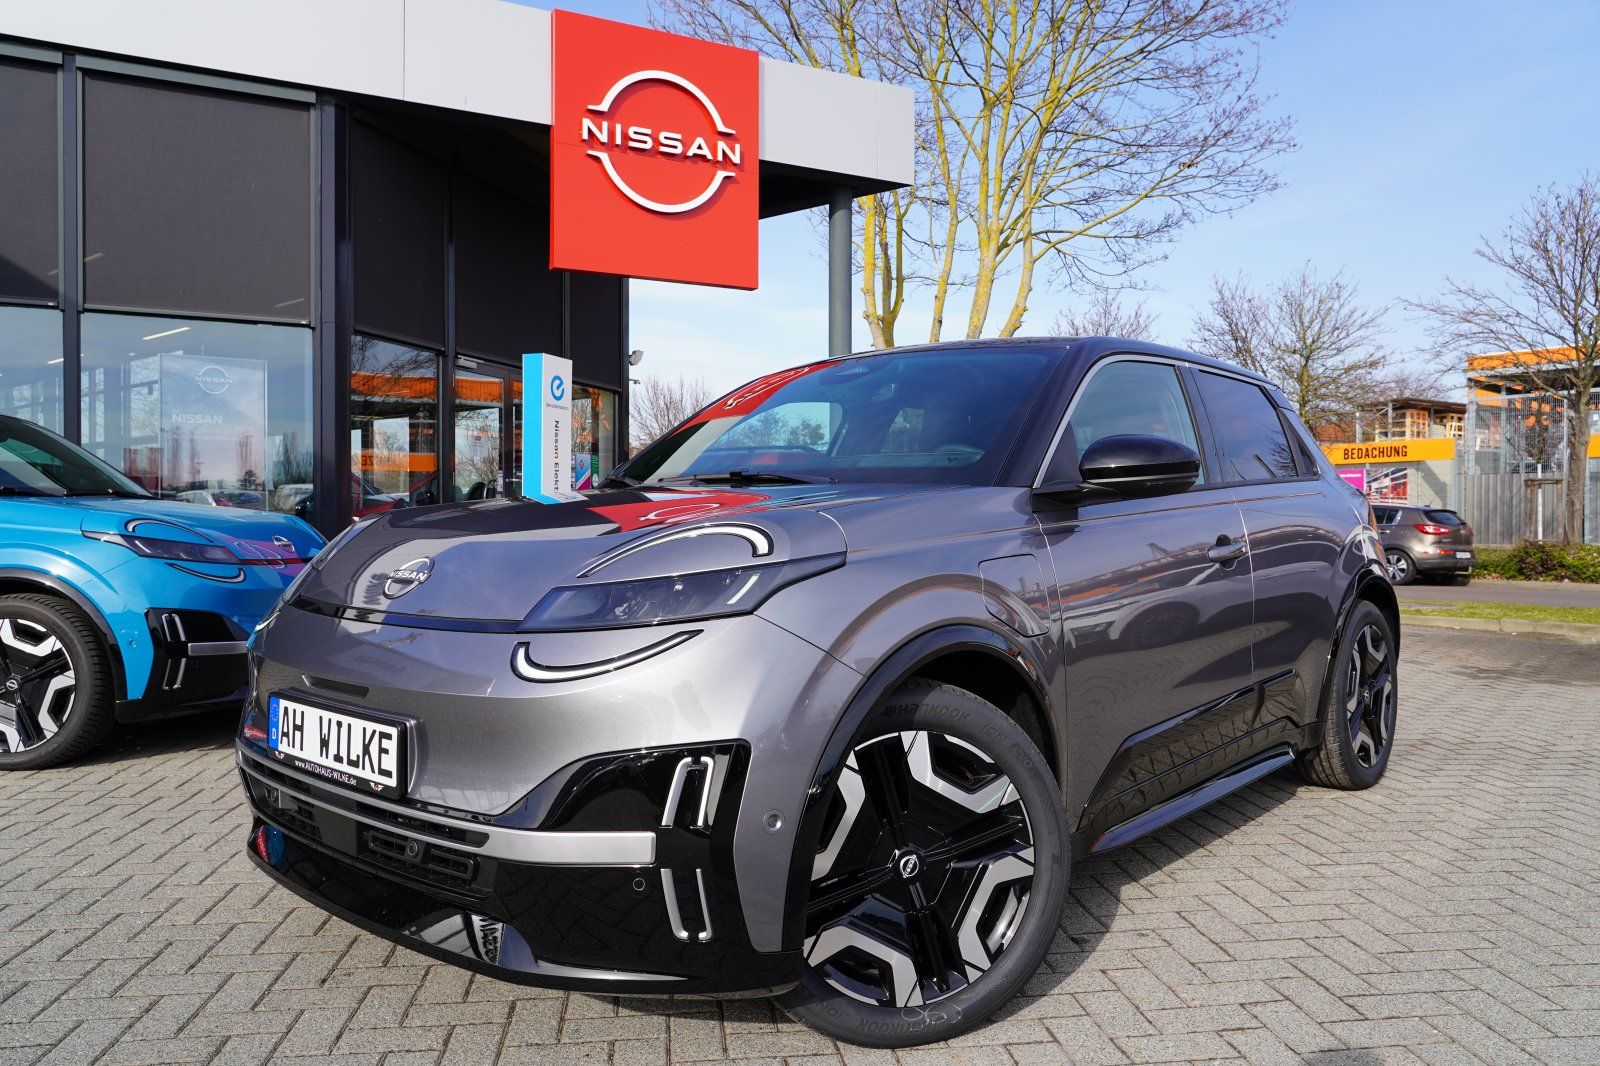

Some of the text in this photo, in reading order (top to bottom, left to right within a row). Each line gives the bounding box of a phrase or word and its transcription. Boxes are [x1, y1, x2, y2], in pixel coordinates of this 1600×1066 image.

[581, 117, 741, 165] NISSAN
[195, 375, 232, 384] NISSAN
[172, 413, 223, 425] NISSAN
[1343, 445, 1408, 460] BEDACHUNG
[280, 706, 393, 779] AH WILKE
